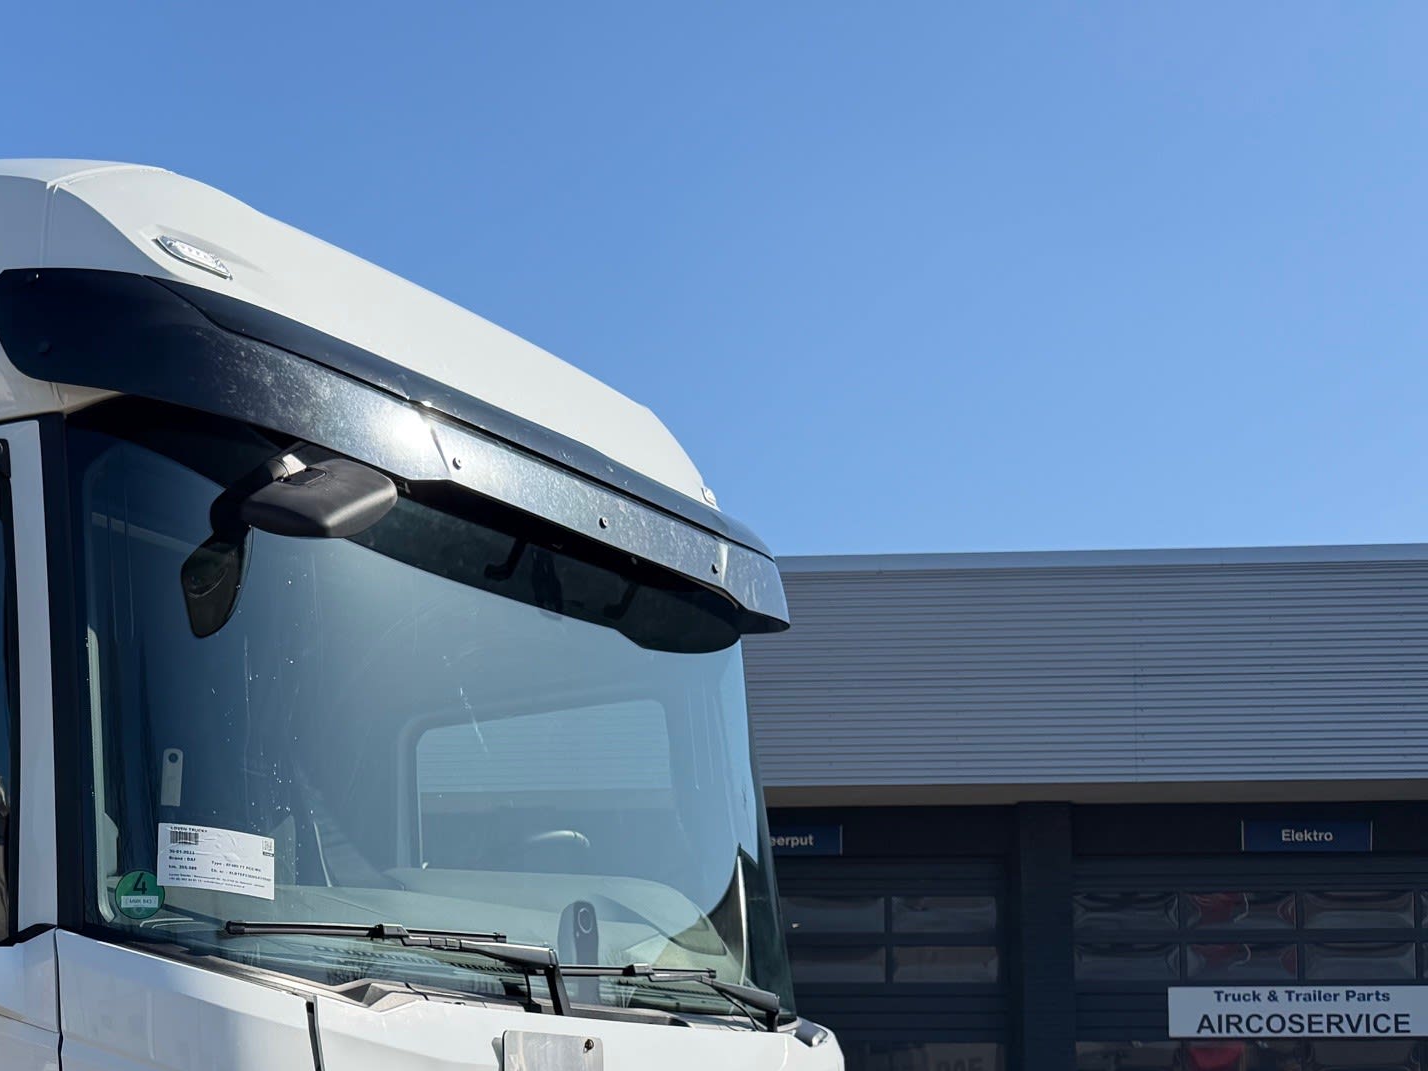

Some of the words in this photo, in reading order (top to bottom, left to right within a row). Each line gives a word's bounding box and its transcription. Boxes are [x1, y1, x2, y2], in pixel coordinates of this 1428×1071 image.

[1281, 829, 1334, 841] Elektro
[133, 872, 147, 894] 4
[1213, 990, 1261, 1002] Truck
[1267, 990, 1279, 1002] &
[1284, 990, 1340, 1002] Trailer
[1346, 990, 1391, 1002] Parts
[1196, 1013, 1411, 1034] AIRCOSERVICE
